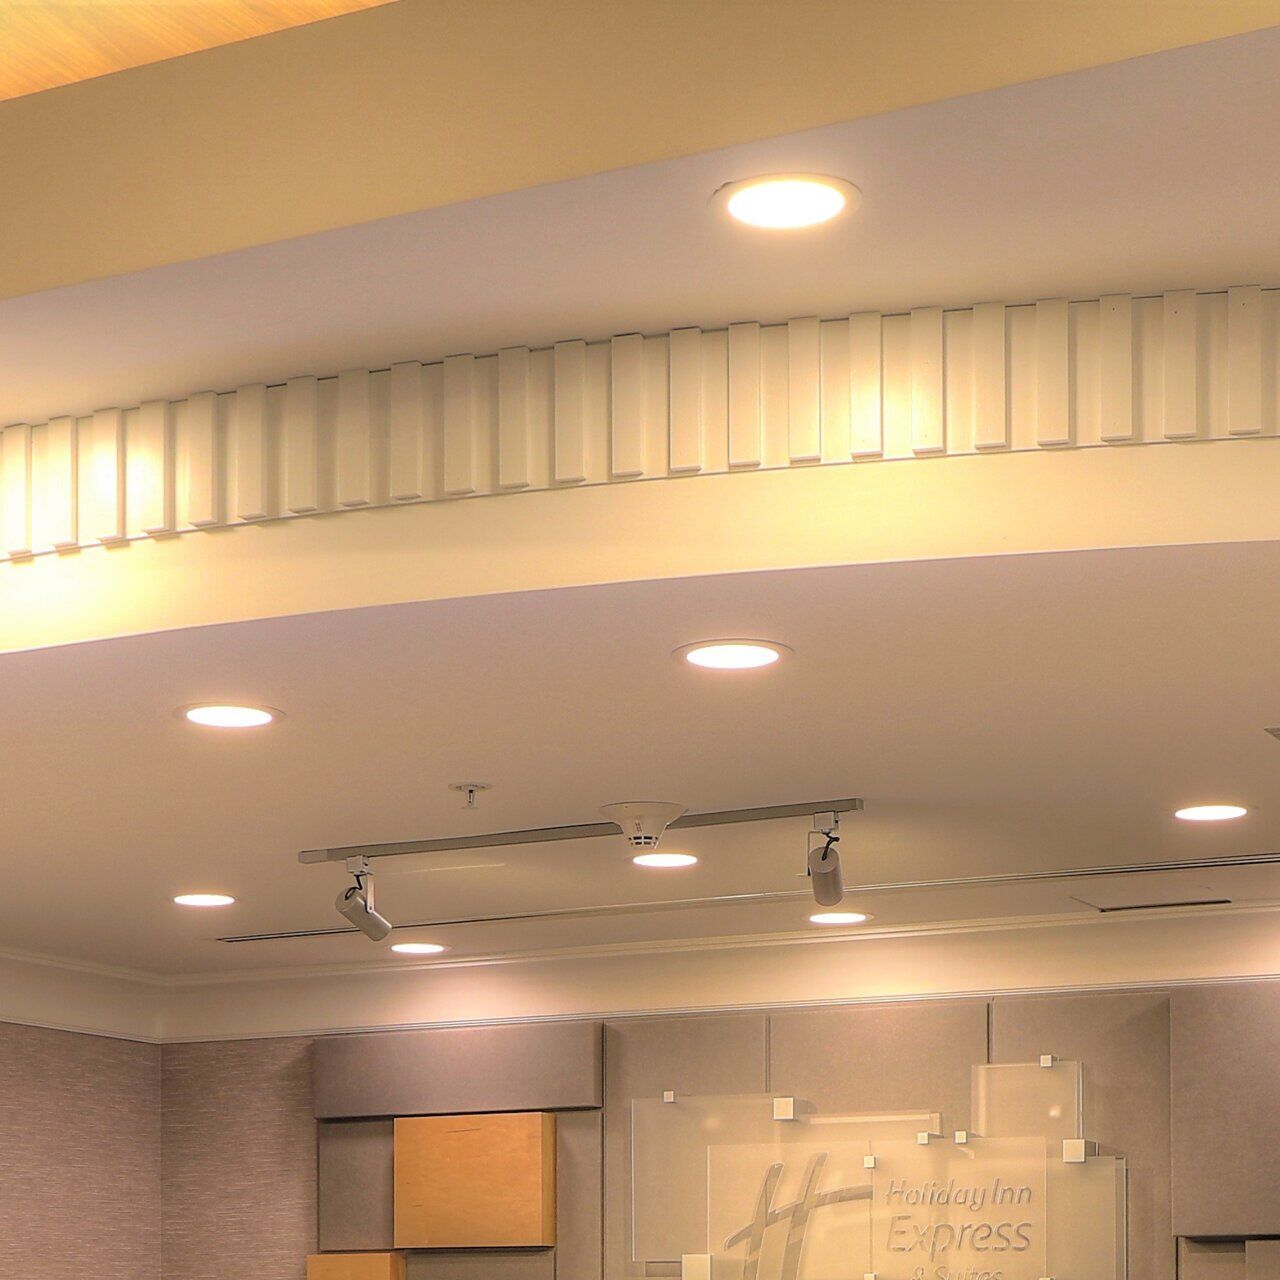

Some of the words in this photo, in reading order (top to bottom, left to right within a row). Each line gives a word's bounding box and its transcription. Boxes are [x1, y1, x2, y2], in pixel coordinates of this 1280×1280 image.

[886, 1178, 986, 1211] Holiday
[992, 1178, 1032, 1204] Inn
[886, 1215, 1032, 1262] Express
